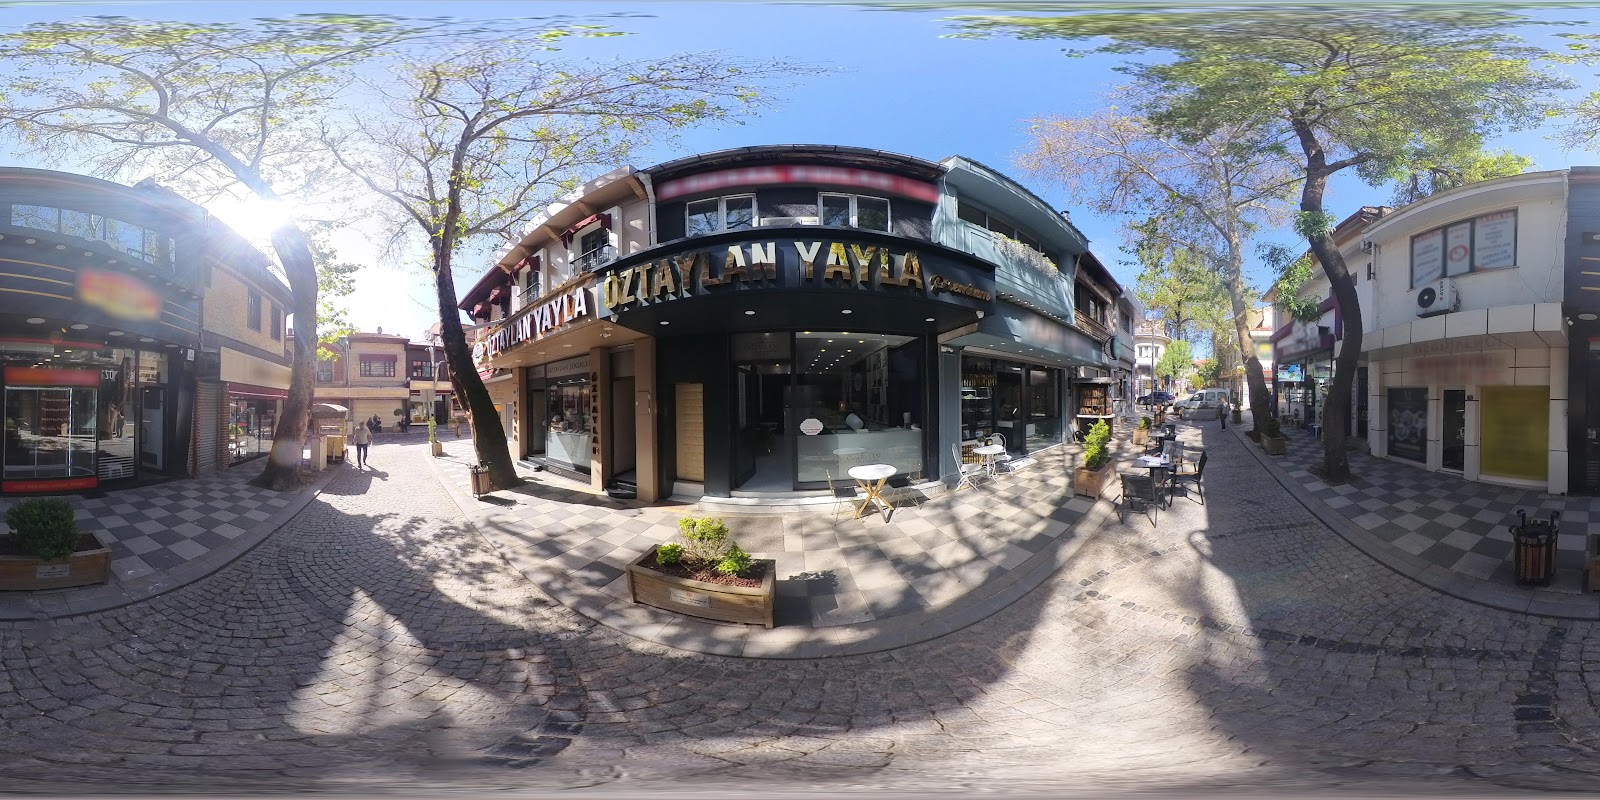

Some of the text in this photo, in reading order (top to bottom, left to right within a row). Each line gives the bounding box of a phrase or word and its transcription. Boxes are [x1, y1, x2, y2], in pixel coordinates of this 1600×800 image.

[603, 241, 777, 309] ÖZTAYLAN
[793, 241, 924, 289] YAYLA
[487, 313, 531, 357] ÖZTAYLAN
[533, 286, 588, 335] YAYLA
